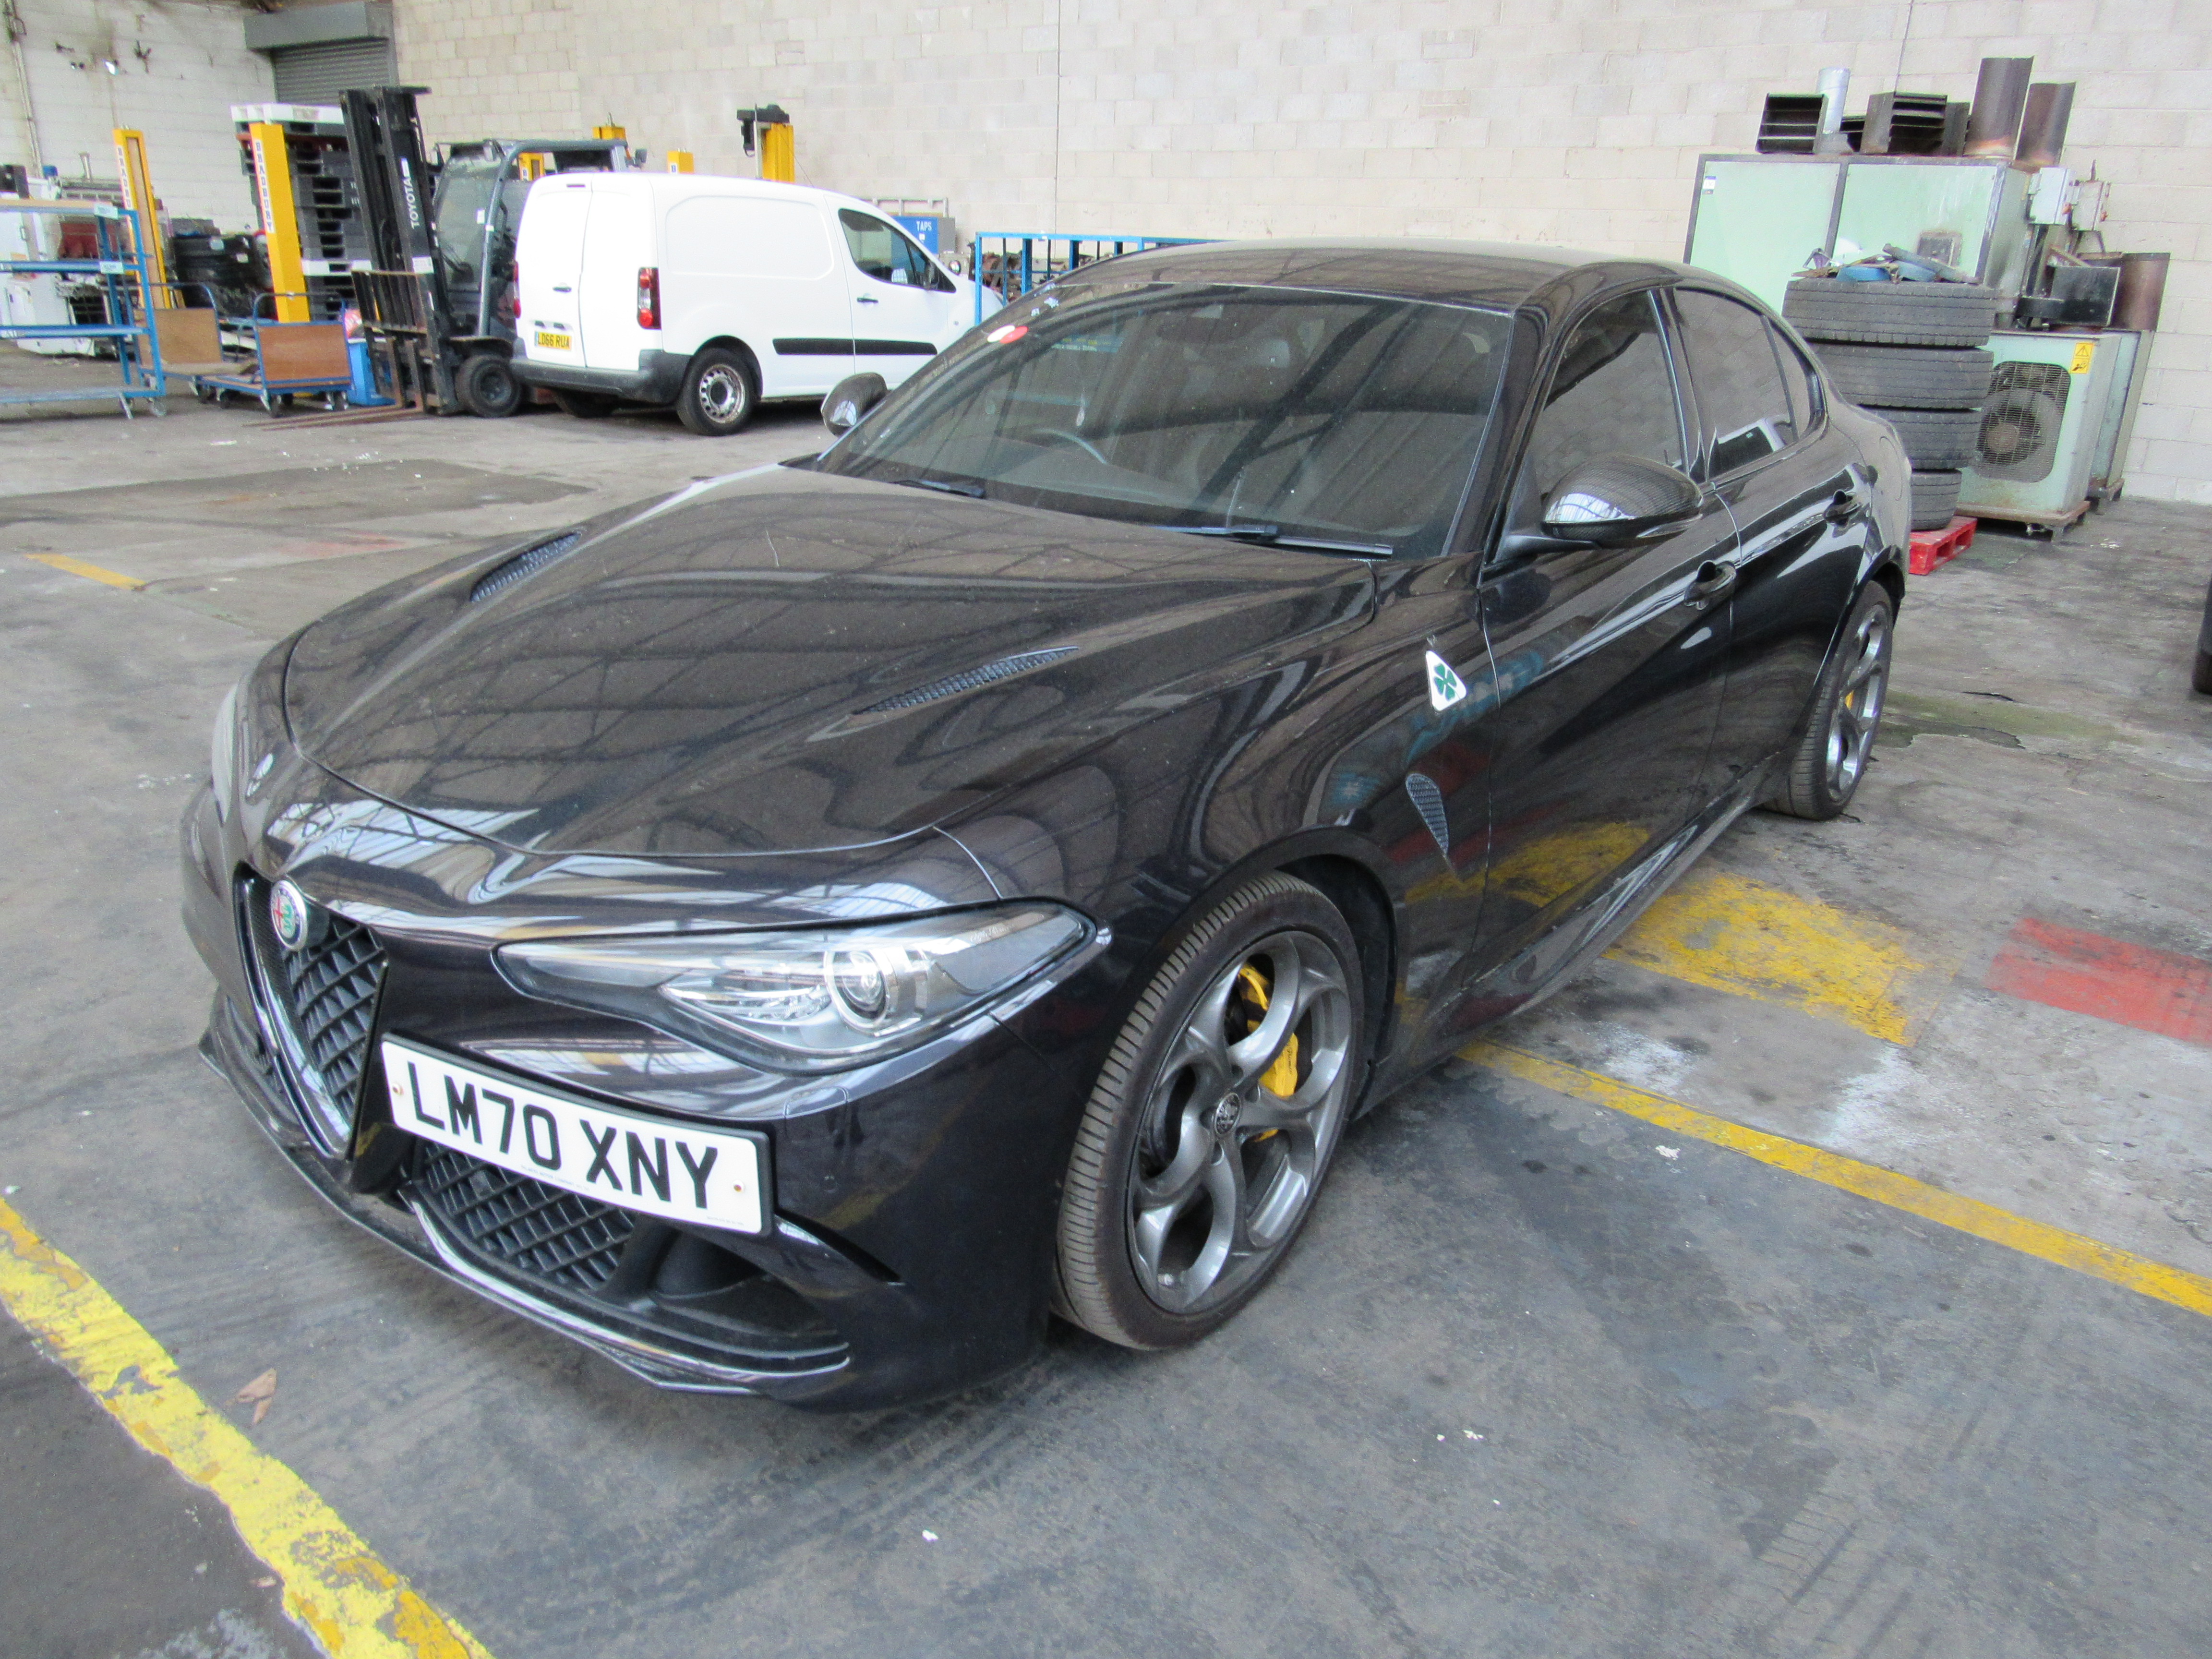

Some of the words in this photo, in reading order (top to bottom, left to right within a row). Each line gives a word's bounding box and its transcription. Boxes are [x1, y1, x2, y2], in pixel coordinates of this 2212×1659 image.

[403, 178, 420, 229] TOYOTA
[916, 221, 932, 231] TAPS
[555, 335, 570, 348] RUA
[408, 1061, 562, 1171] LM70
[579, 1118, 718, 1209] XNY
